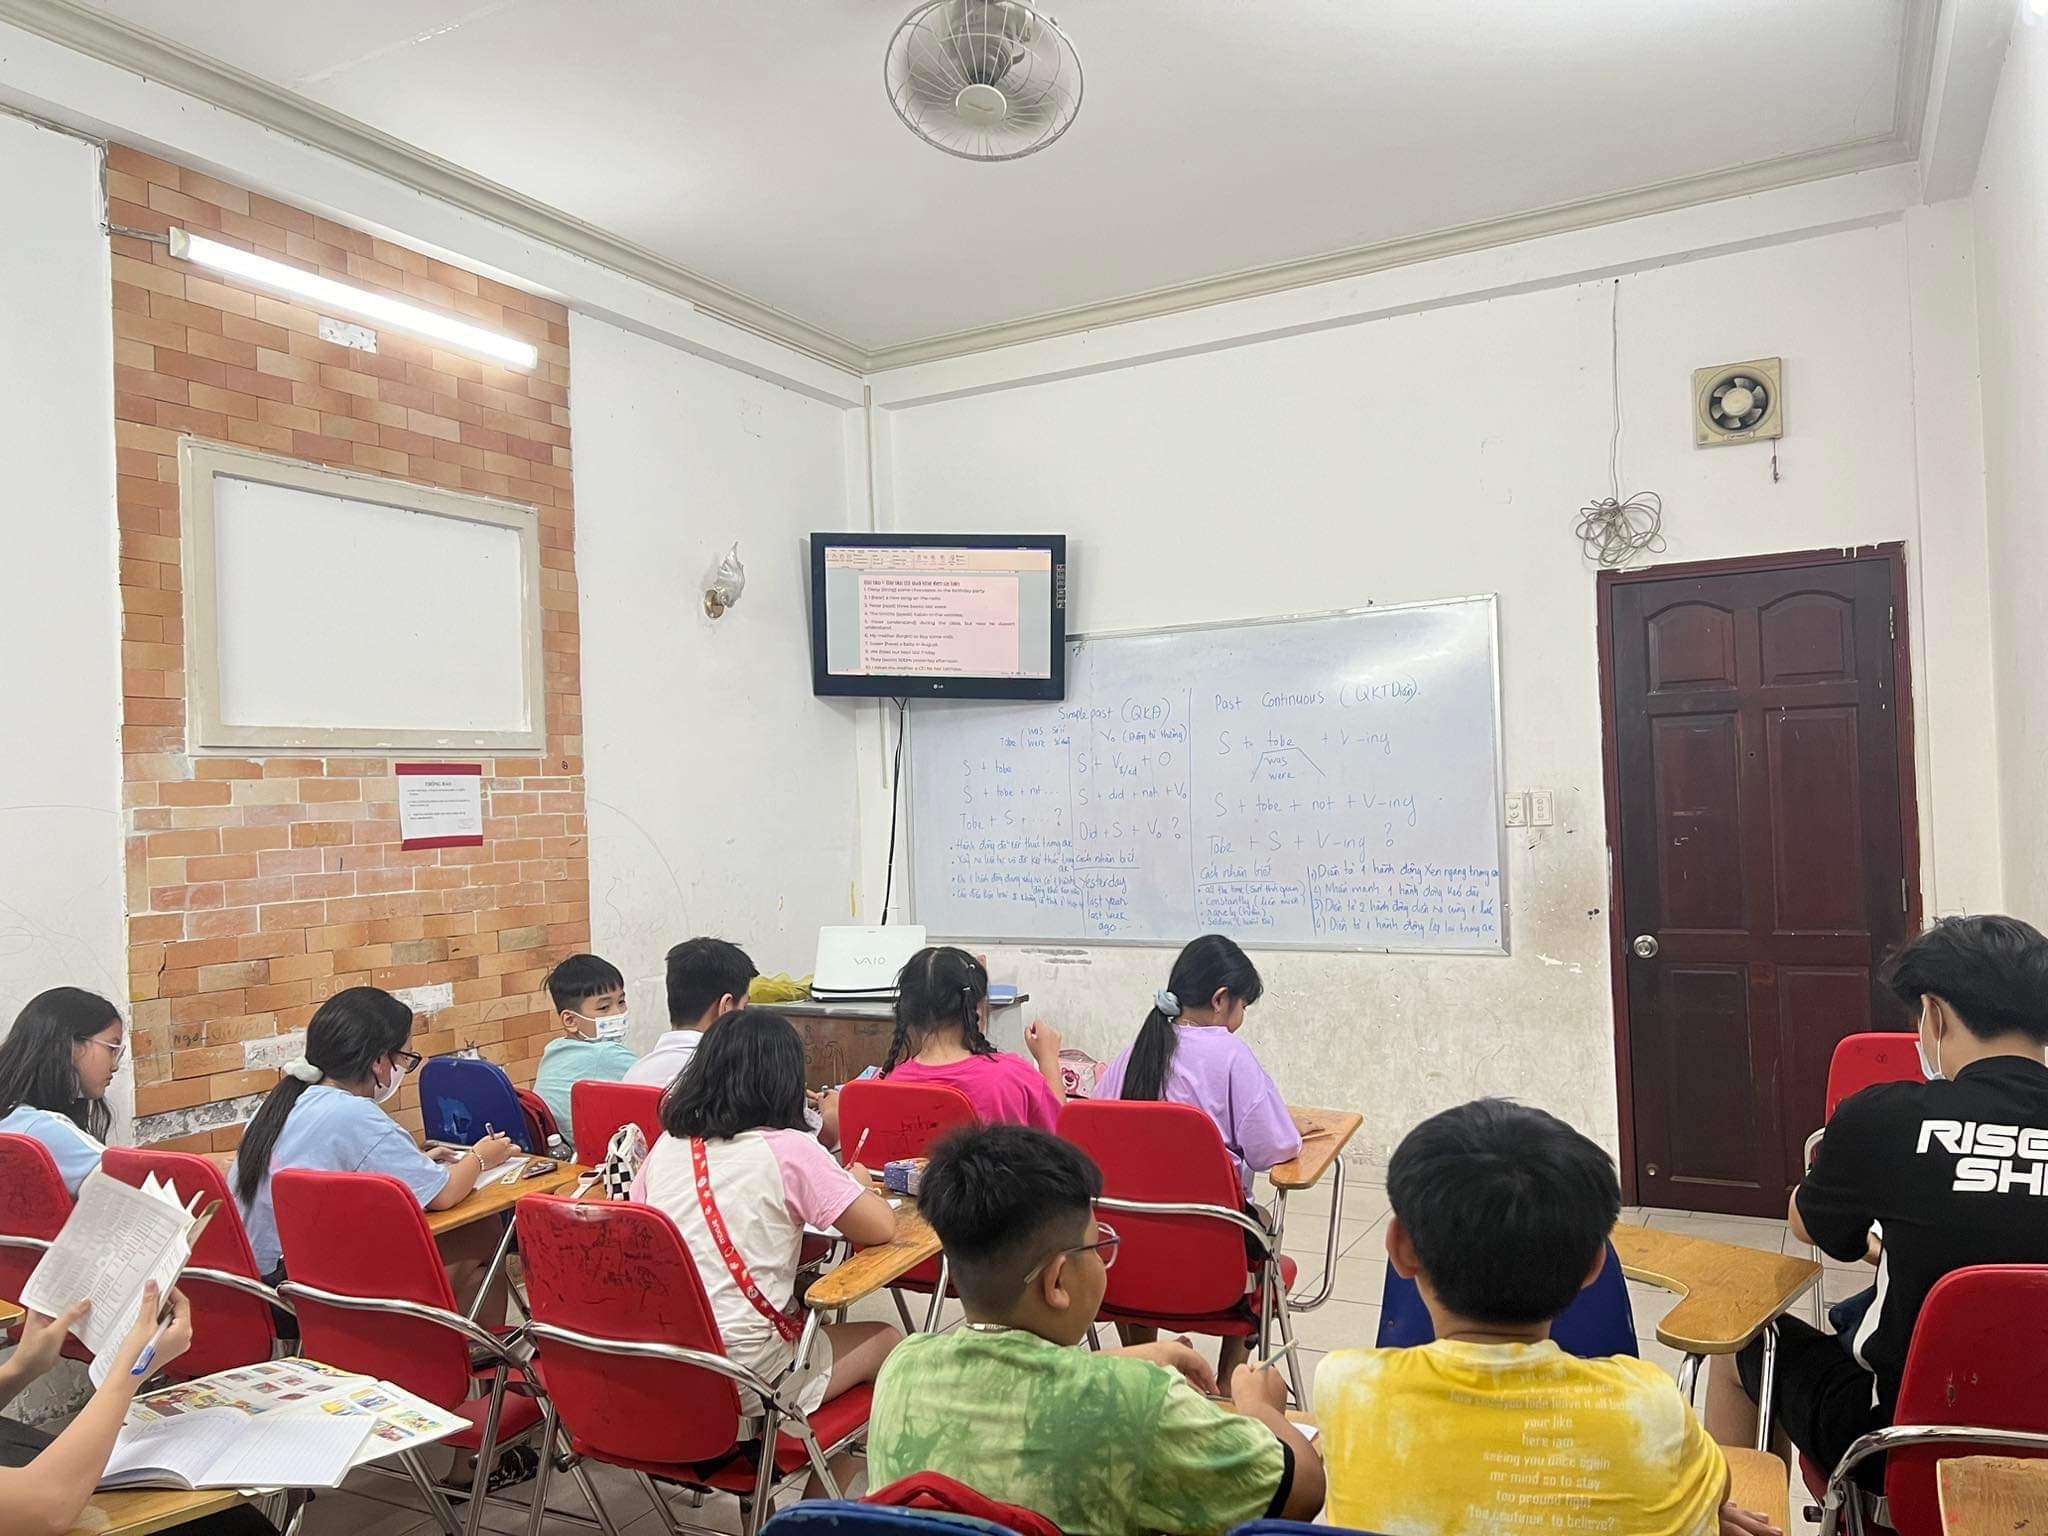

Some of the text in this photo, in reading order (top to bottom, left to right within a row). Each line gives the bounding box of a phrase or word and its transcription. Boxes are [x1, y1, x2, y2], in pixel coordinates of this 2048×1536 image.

[1215, 693, 1242, 711] Past
[1261, 691, 1326, 708] Continuous
[1218, 730, 1232, 755] S
[1267, 729, 1295, 747] tobe
[1214, 792, 1228, 817] S
[1256, 794, 1282, 811] tobe
[1312, 796, 1336, 810] not
[1268, 830, 1282, 851] S
[854, 956, 886, 965] VAIO
[1523, 1415, 1574, 1430] your like
